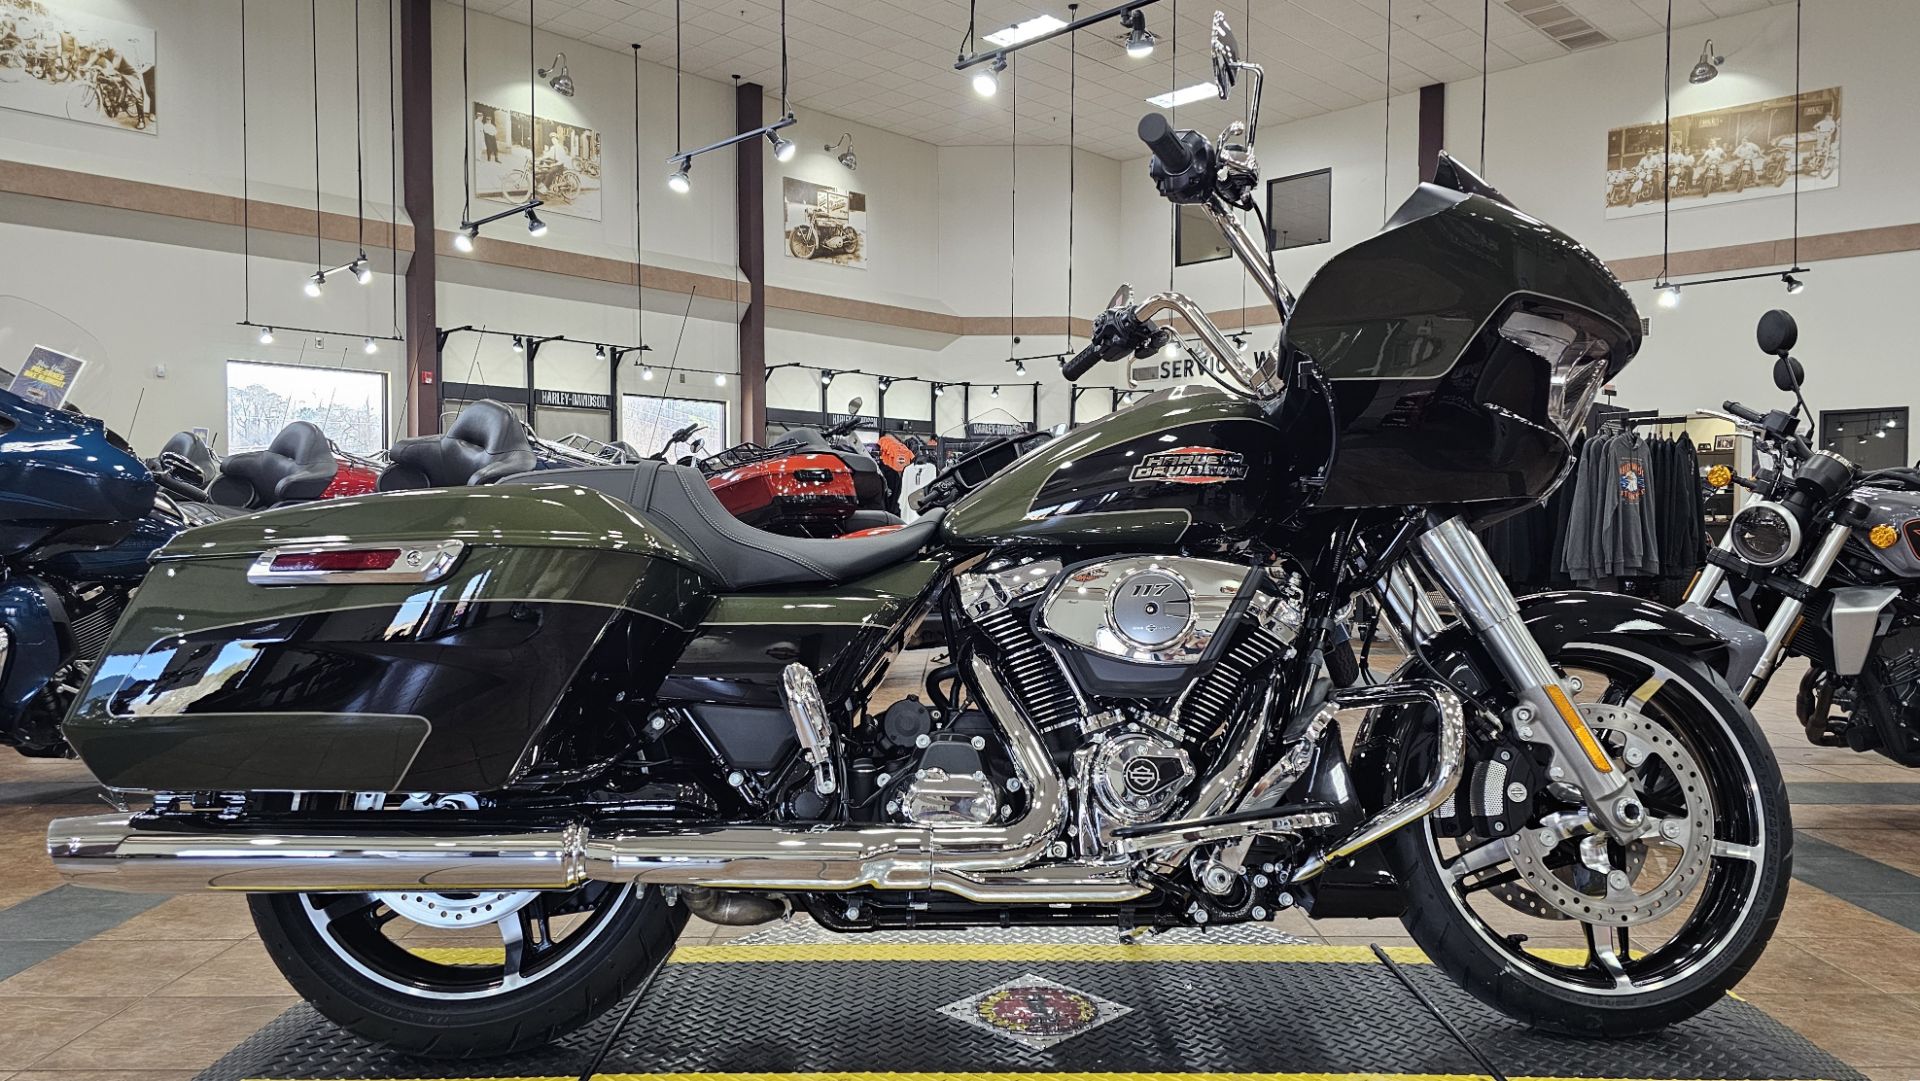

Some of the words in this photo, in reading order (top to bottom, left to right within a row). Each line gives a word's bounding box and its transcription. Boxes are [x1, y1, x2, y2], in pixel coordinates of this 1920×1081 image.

[541, 390, 608, 408] HARLEY-DAVIDSON
[1134, 464, 1243, 479] DAVIDSON
[1130, 583, 1173, 597] 117
